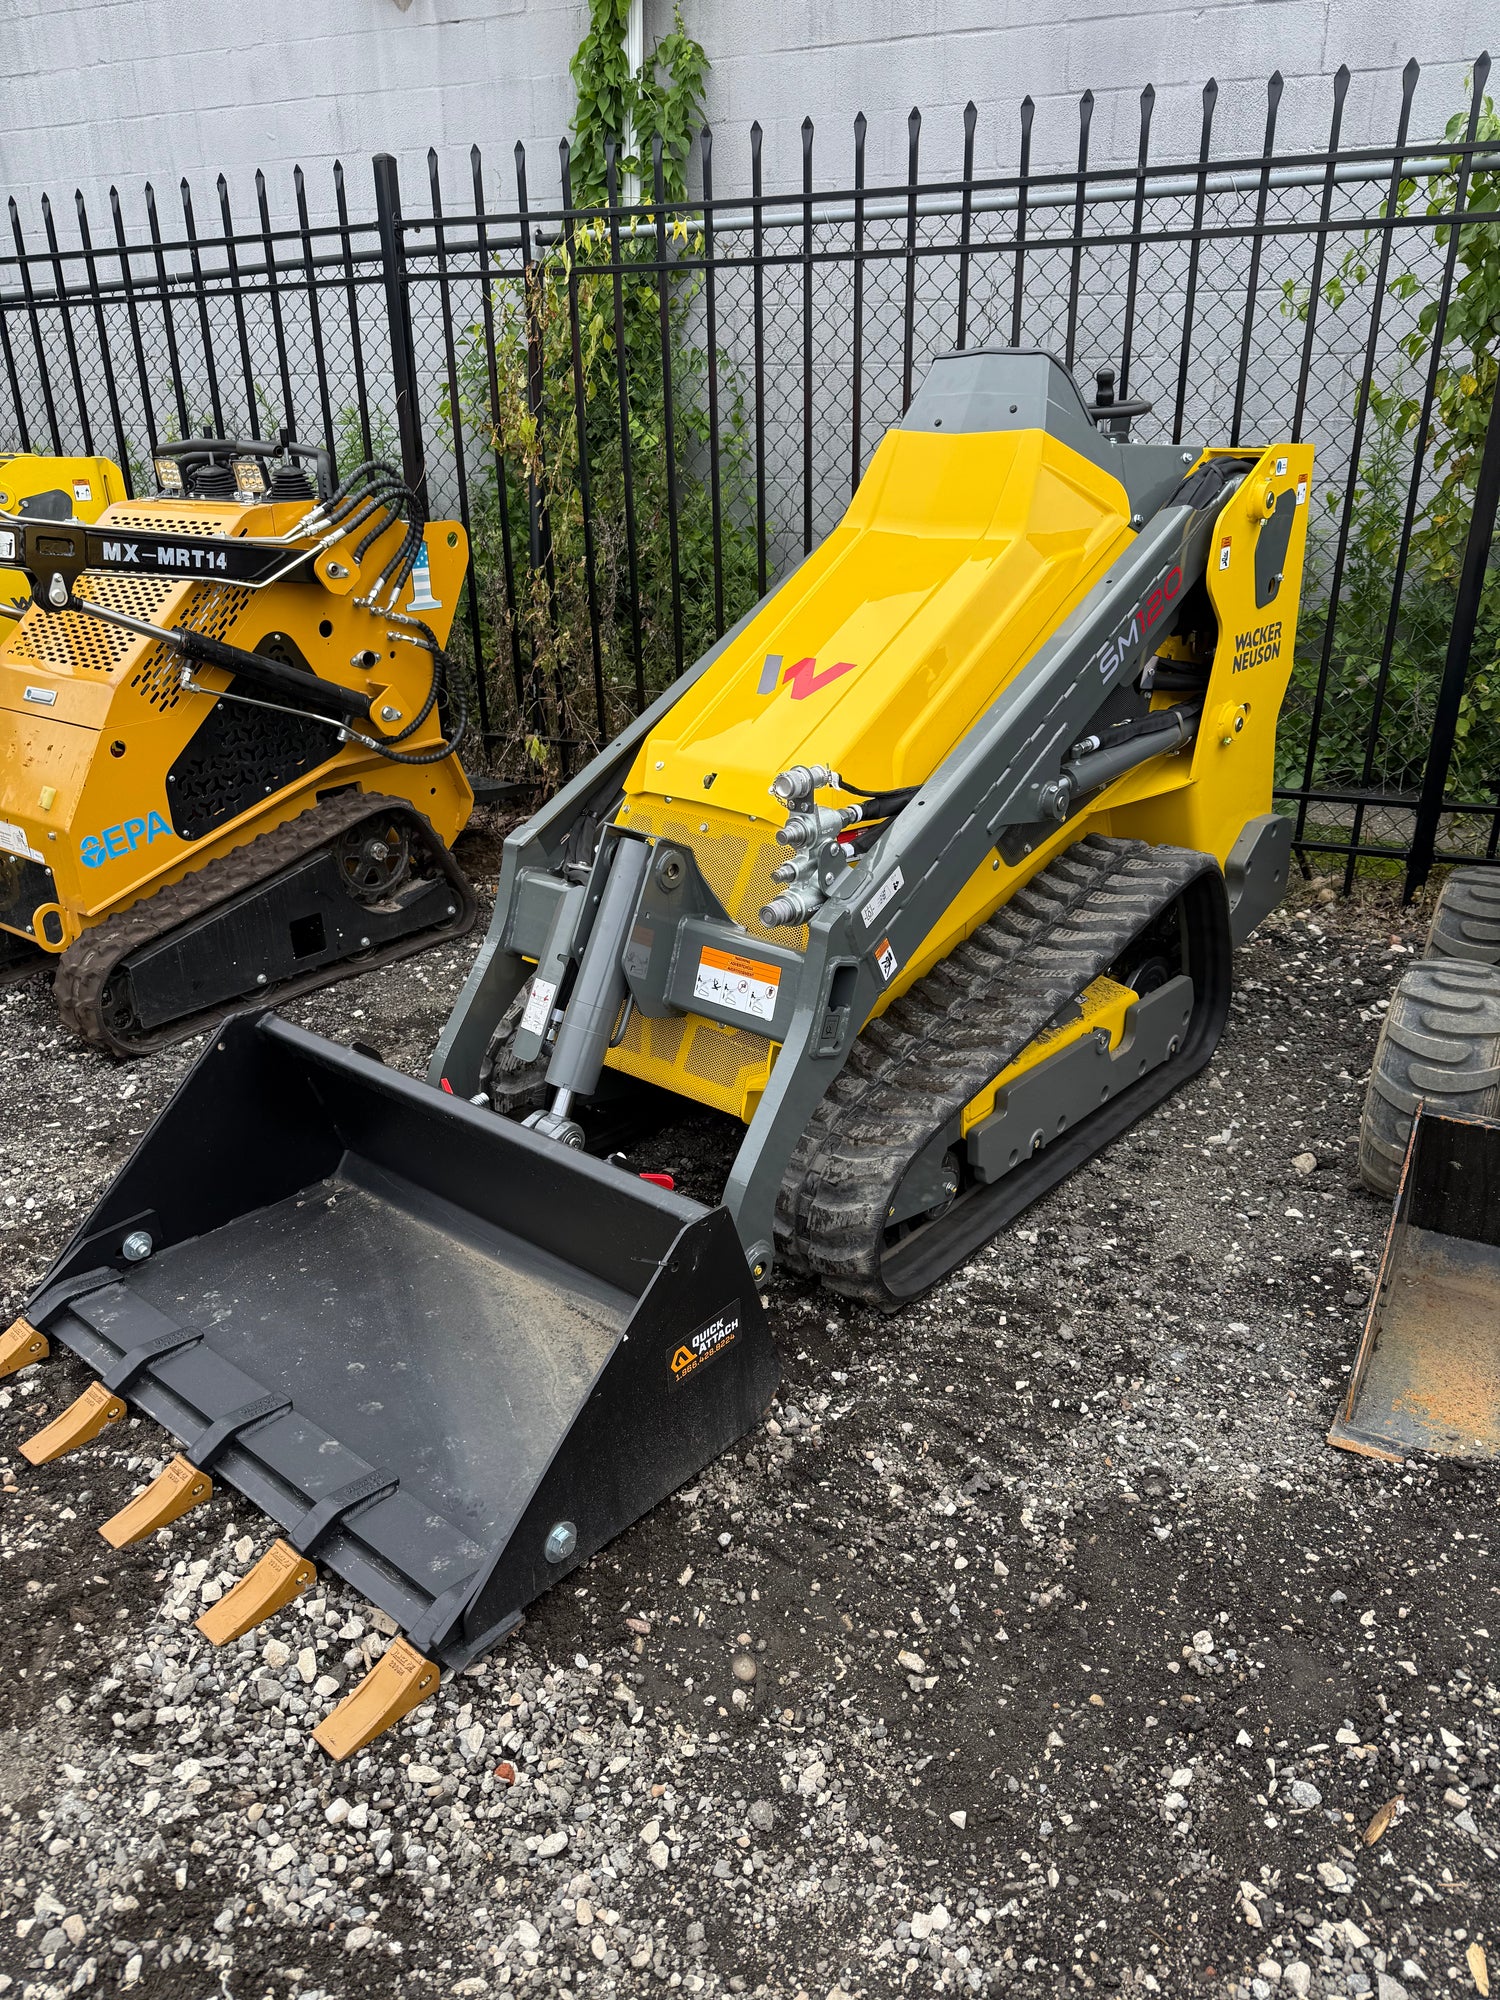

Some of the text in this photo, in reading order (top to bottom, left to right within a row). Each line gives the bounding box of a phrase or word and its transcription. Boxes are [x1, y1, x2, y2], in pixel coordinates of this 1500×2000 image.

[102, 541, 228, 570] MX-MRT14
[1099, 565, 1183, 686] SM120
[1235, 621, 1282, 653] WACKER
[1232, 640, 1281, 675] NEUSON
[101, 810, 174, 860] EPA
[692, 1317, 724, 1348] QUICK
[698, 1318, 739, 1355] ATTACH
